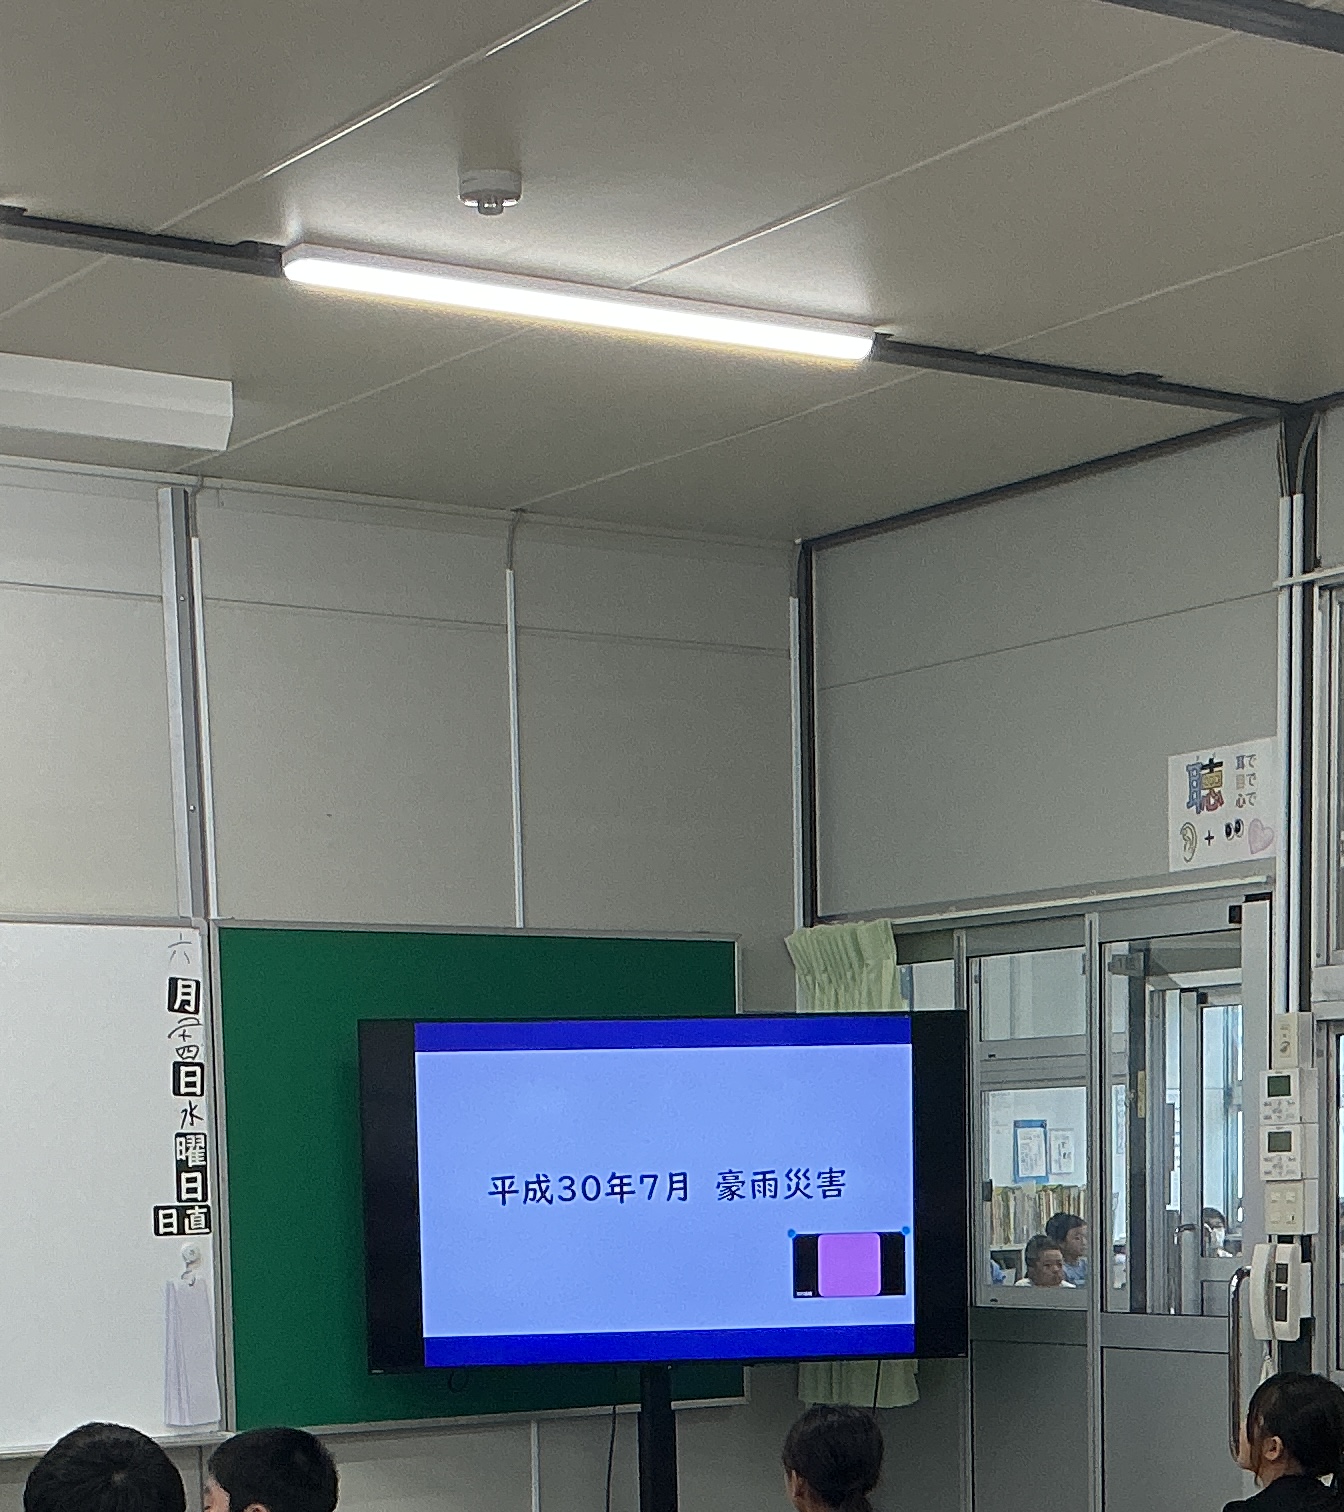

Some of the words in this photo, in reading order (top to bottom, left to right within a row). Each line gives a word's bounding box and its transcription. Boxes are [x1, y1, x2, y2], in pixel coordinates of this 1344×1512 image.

[1235, 753, 1257, 770] 耳で
[1186, 757, 1224, 814] 聴
[1235, 772, 1257, 790] 目で
[1235, 791, 1257, 809] 心で
[487, 1171, 690, 1206] 平成30年7月
[714, 1166, 847, 1201] 豪雨災害
[157, 1205, 211, 1236] 日直
